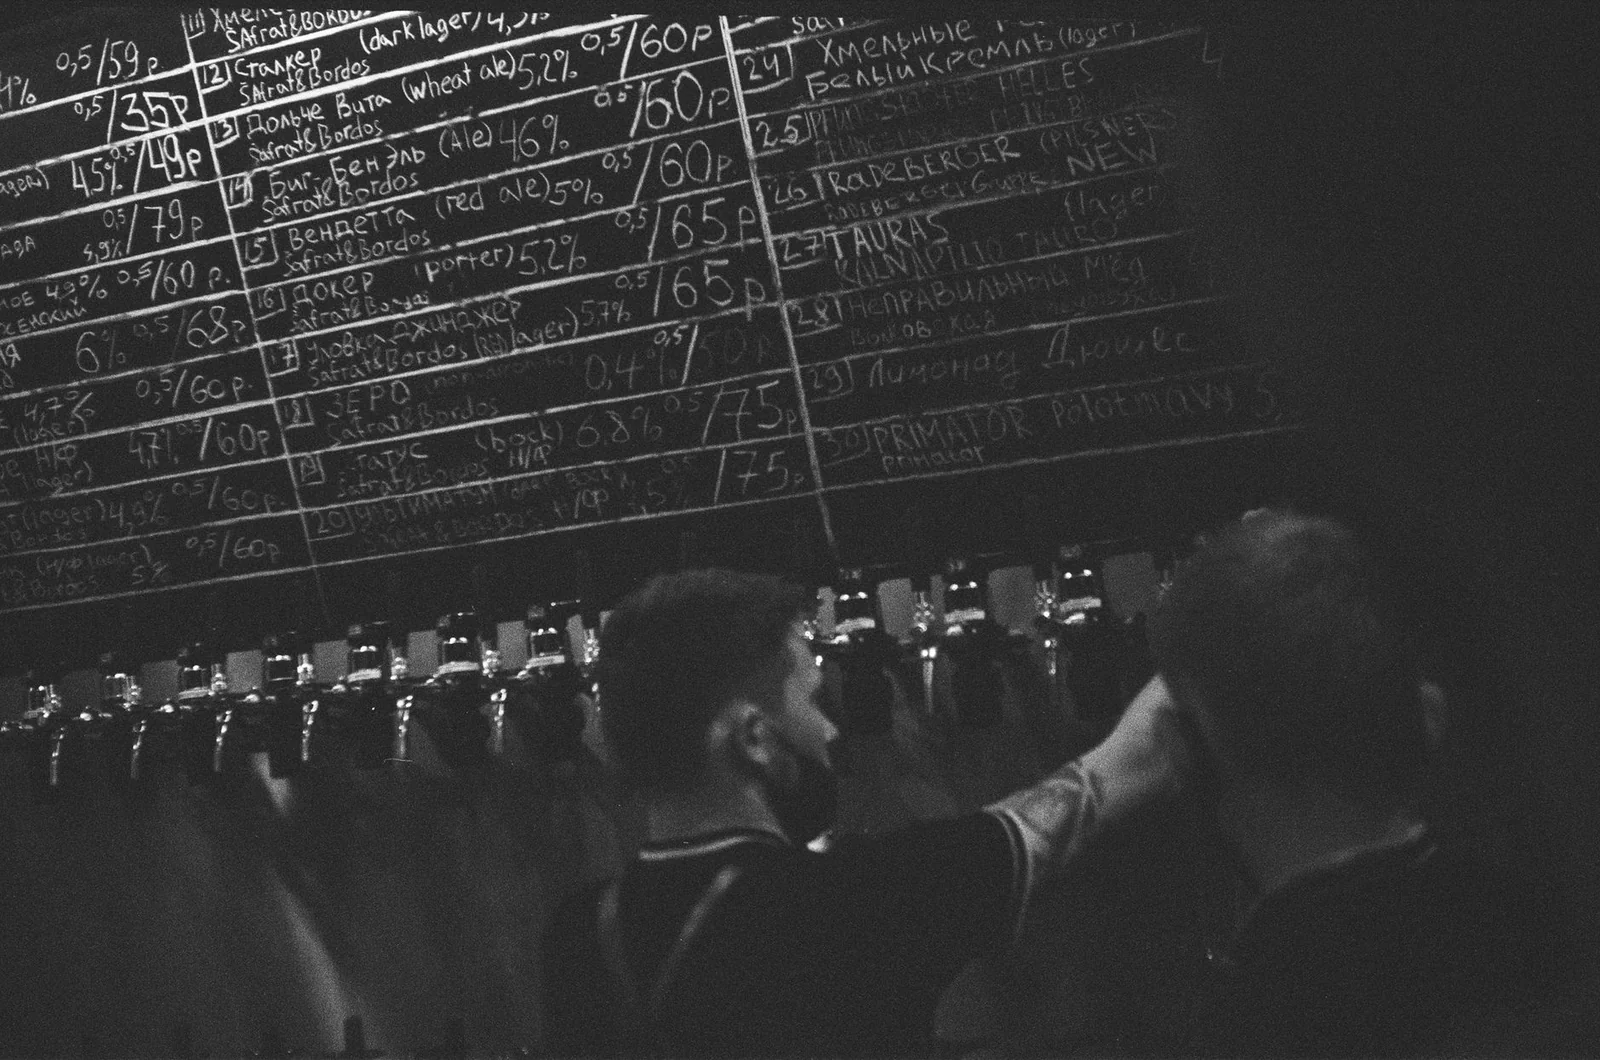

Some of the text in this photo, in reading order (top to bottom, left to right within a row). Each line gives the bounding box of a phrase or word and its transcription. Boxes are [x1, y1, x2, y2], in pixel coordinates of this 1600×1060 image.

[743, 53, 781, 82] 24
[814, 18, 979, 68] Хмельные
[246, 103, 324, 140] Дольче
[335, 92, 392, 118] Вита
[288, 206, 416, 250] Вендетта
[549, 178, 604, 206] 5%
[292, 271, 374, 307] Докер
